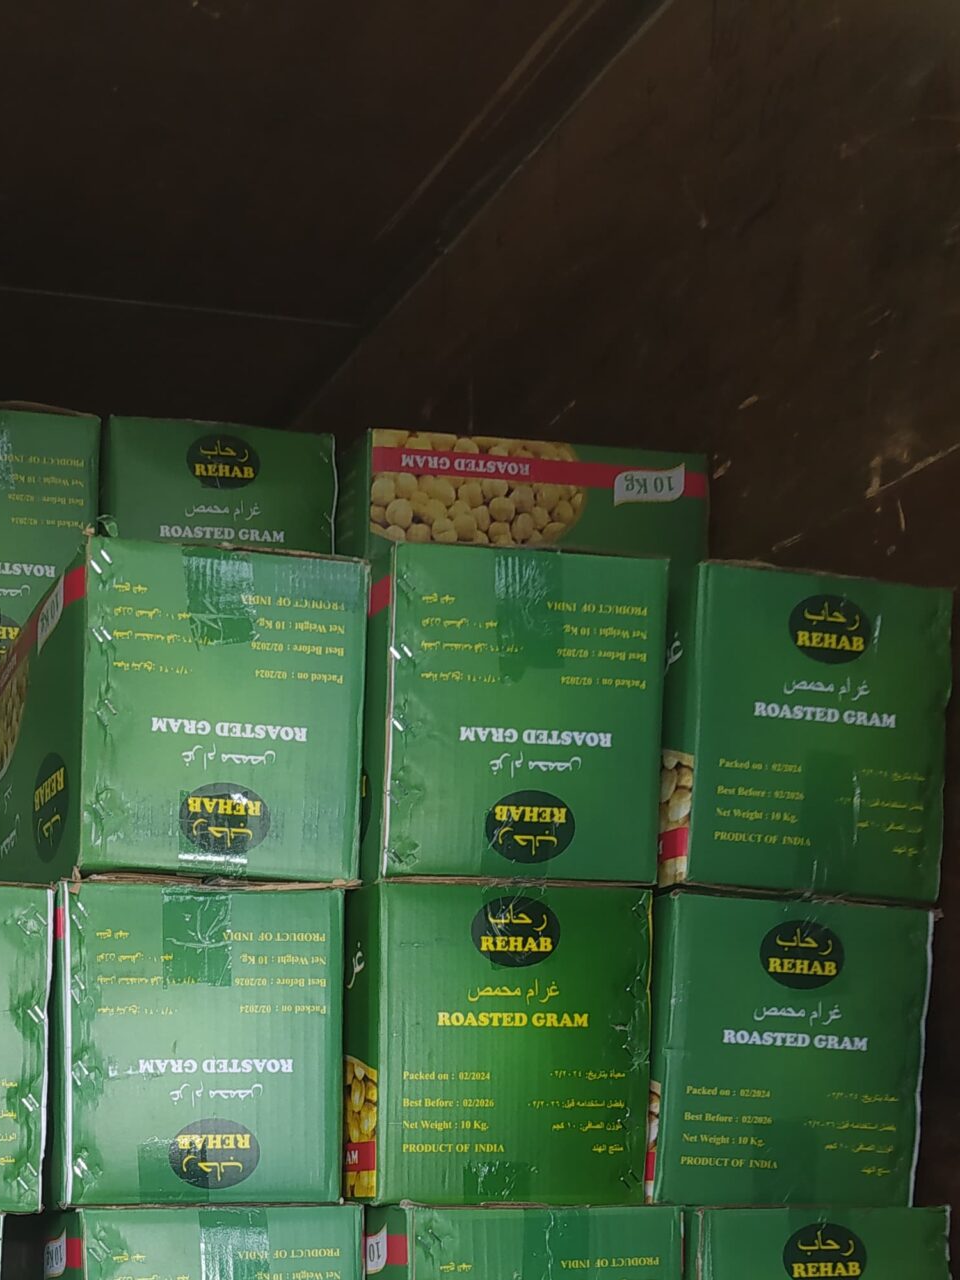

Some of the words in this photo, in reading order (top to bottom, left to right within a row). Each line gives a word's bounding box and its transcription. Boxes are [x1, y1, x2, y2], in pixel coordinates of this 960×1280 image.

[200, 440, 248, 462] رحاب
[402, 454, 450, 469] GRAM
[454, 459, 529, 475] ROASTED
[195, 464, 254, 478] REHAB
[624, 474, 649, 494] Kg
[653, 476, 674, 493] 10
[160, 526, 234, 539] ROASTED
[239, 529, 284, 542] GRAM
[805, 603, 859, 630] رحاب
[797, 631, 864, 651] REHAB
[754, 702, 839, 722] ROASTED
[843, 710, 895, 728] GRAM
[152, 718, 211, 734] GRAM
[216, 722, 307, 741] ROASTED
[460, 727, 518, 742] GRAM
[523, 730, 611, 747] ROASTED
[182, 744, 216, 769] غرام
[222, 751, 275, 764] محمص
[188, 794, 261, 815] REHAB
[495, 806, 566, 823] REHAB
[193, 819, 253, 847] رحاب
[488, 903, 547, 938] رحاب
[481, 936, 552, 951] REHAB
[769, 958, 836, 975] REHAB
[468, 987, 521, 1001] محمص
[527, 979, 559, 1005] غرام
[438, 1012, 527, 1026] ROASTED
[532, 1013, 588, 1027] GRAM
[723, 1030, 810, 1047] ROASTED
[814, 1035, 867, 1050] GRAM
[139, 1060, 197, 1073] GRAM
[202, 1059, 292, 1073] ROASTED
[403, 1071, 435, 1080] Packed
[458, 1072, 491, 1080] 02/2024
[403, 1098, 422, 1107] Best
[424, 1098, 454, 1107] Before
[462, 1098, 495, 1107] 02/2026
[402, 1120, 418, 1129] Net
[420, 1120, 452, 1132] Weight
[460, 1120, 471, 1129] 10
[473, 1120, 489, 1132] Kg.
[175, 1134, 250, 1150] REHAB
[402, 1143, 453, 1153] PRODUCT
[456, 1143, 470, 1153] OF
[474, 1143, 505, 1153] INDIA
[798, 1231, 854, 1256] رحاب
[793, 1262, 860, 1277] REHAB
